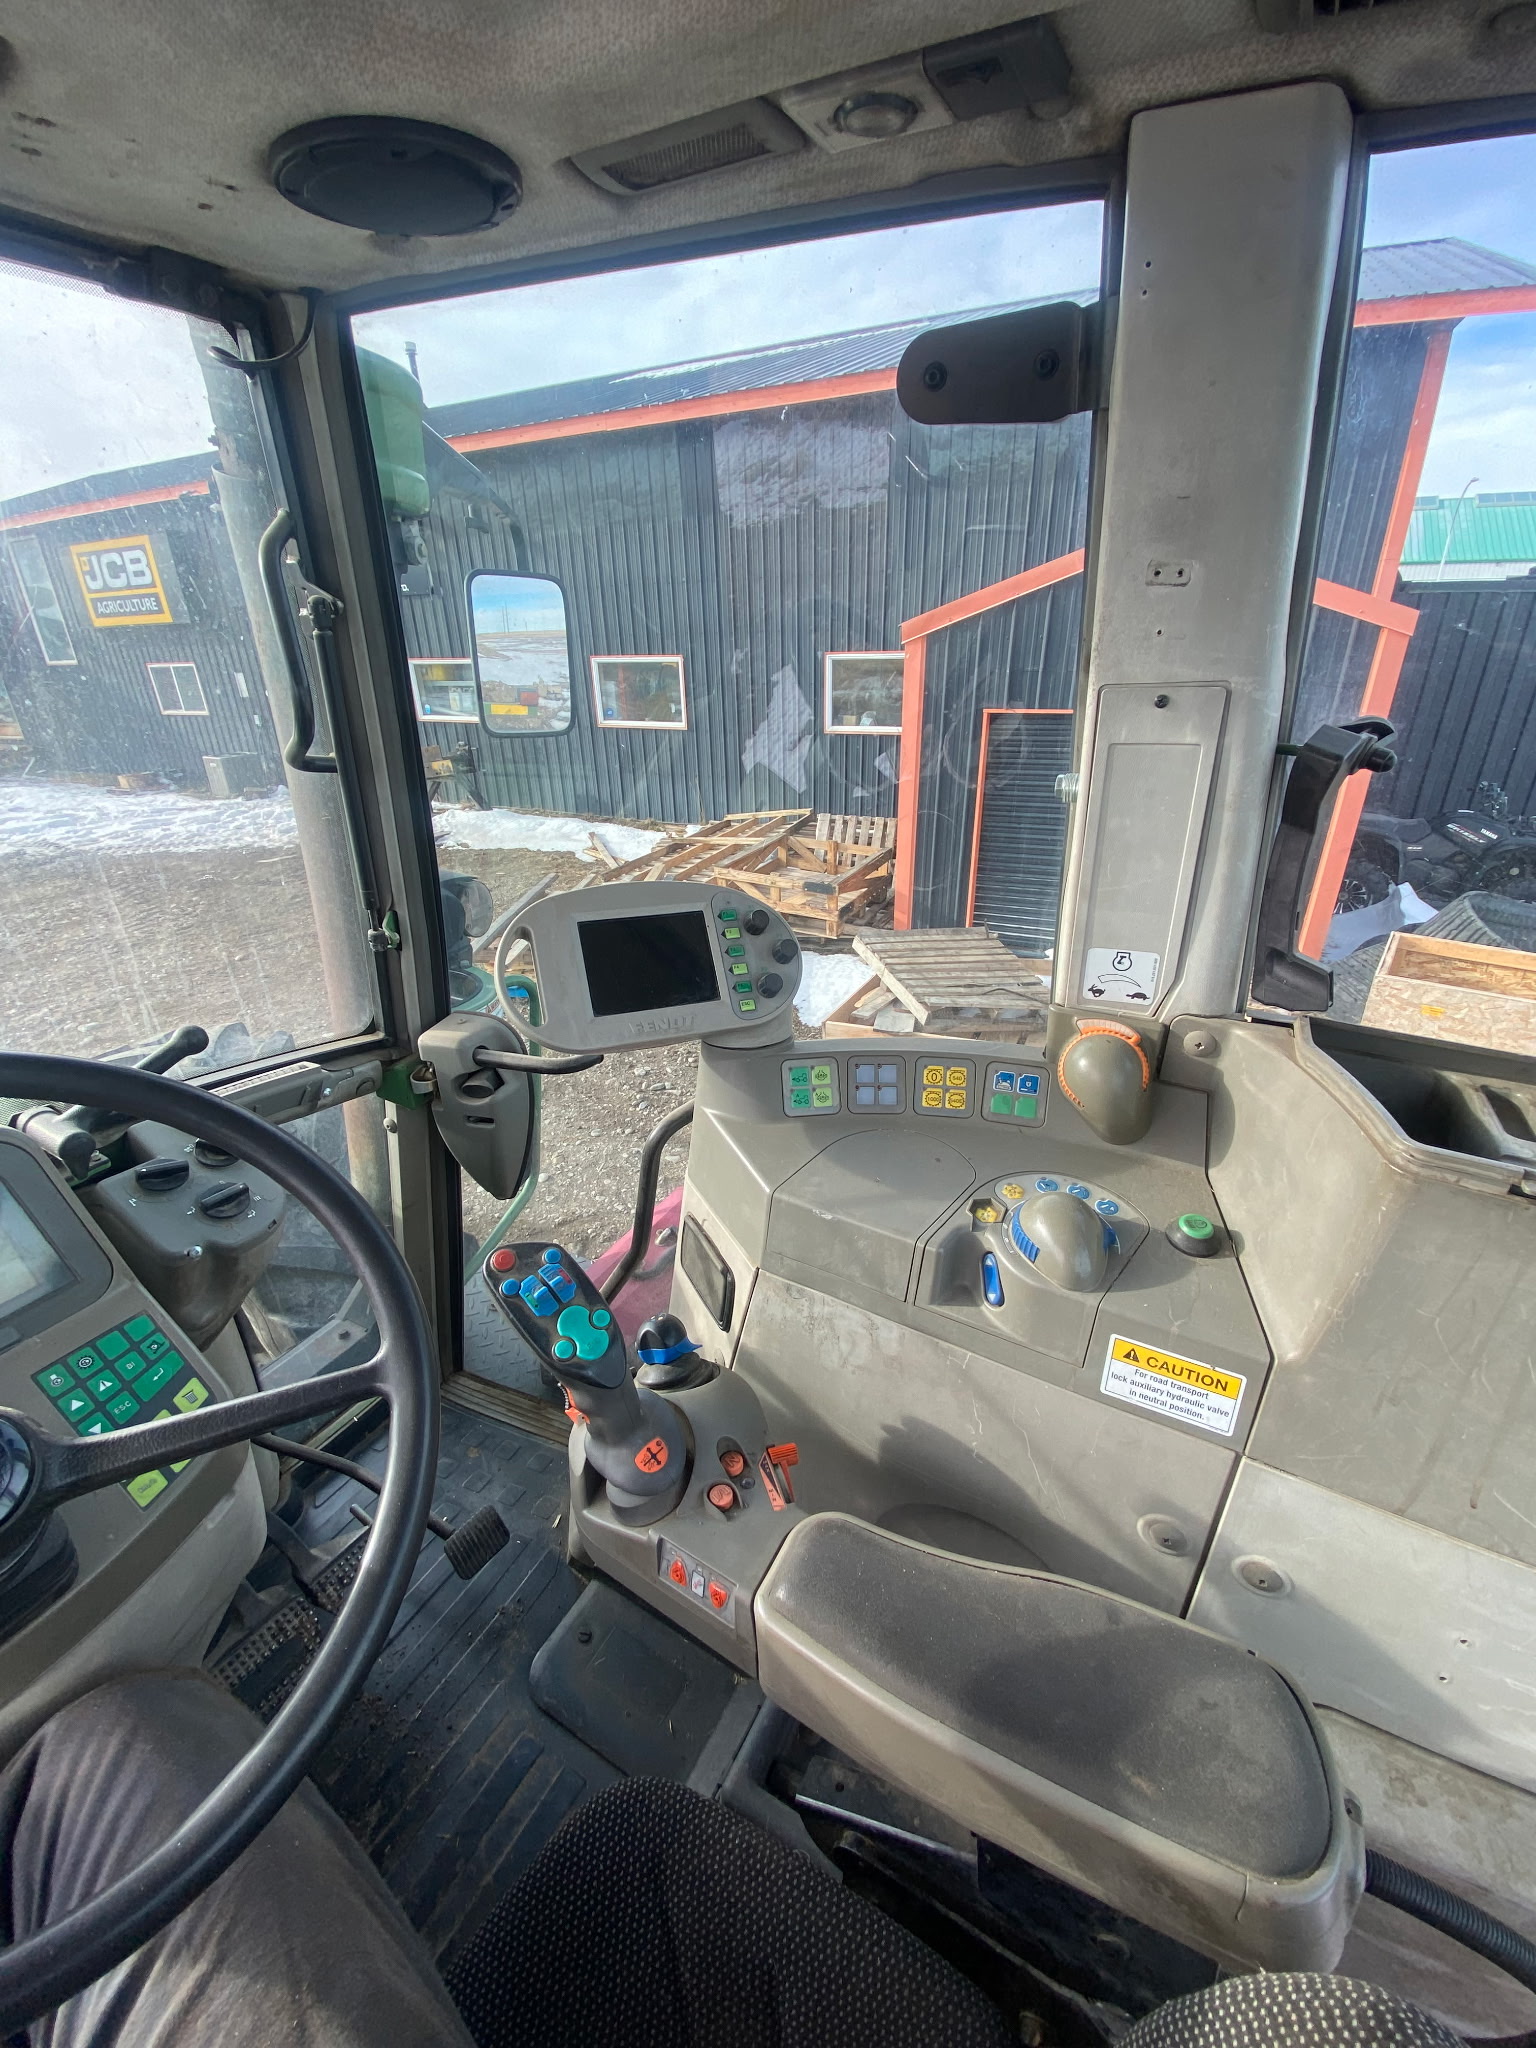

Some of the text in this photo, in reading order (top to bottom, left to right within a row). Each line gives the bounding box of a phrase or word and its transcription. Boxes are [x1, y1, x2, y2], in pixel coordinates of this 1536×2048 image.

[85, 549, 153, 590] JCB
[97, 598, 158, 614] AGRICULTURE
[629, 1014, 697, 1033] FENDT
[1134, 1368, 1209, 1400] For road transport
[1146, 1356, 1229, 1392] CAUTION
[113, 1400, 132, 1416] ESC
[1111, 1371, 1229, 1418] lock auxiliary hydraulic valve
[1129, 1388, 1205, 1420] in neutral position.
